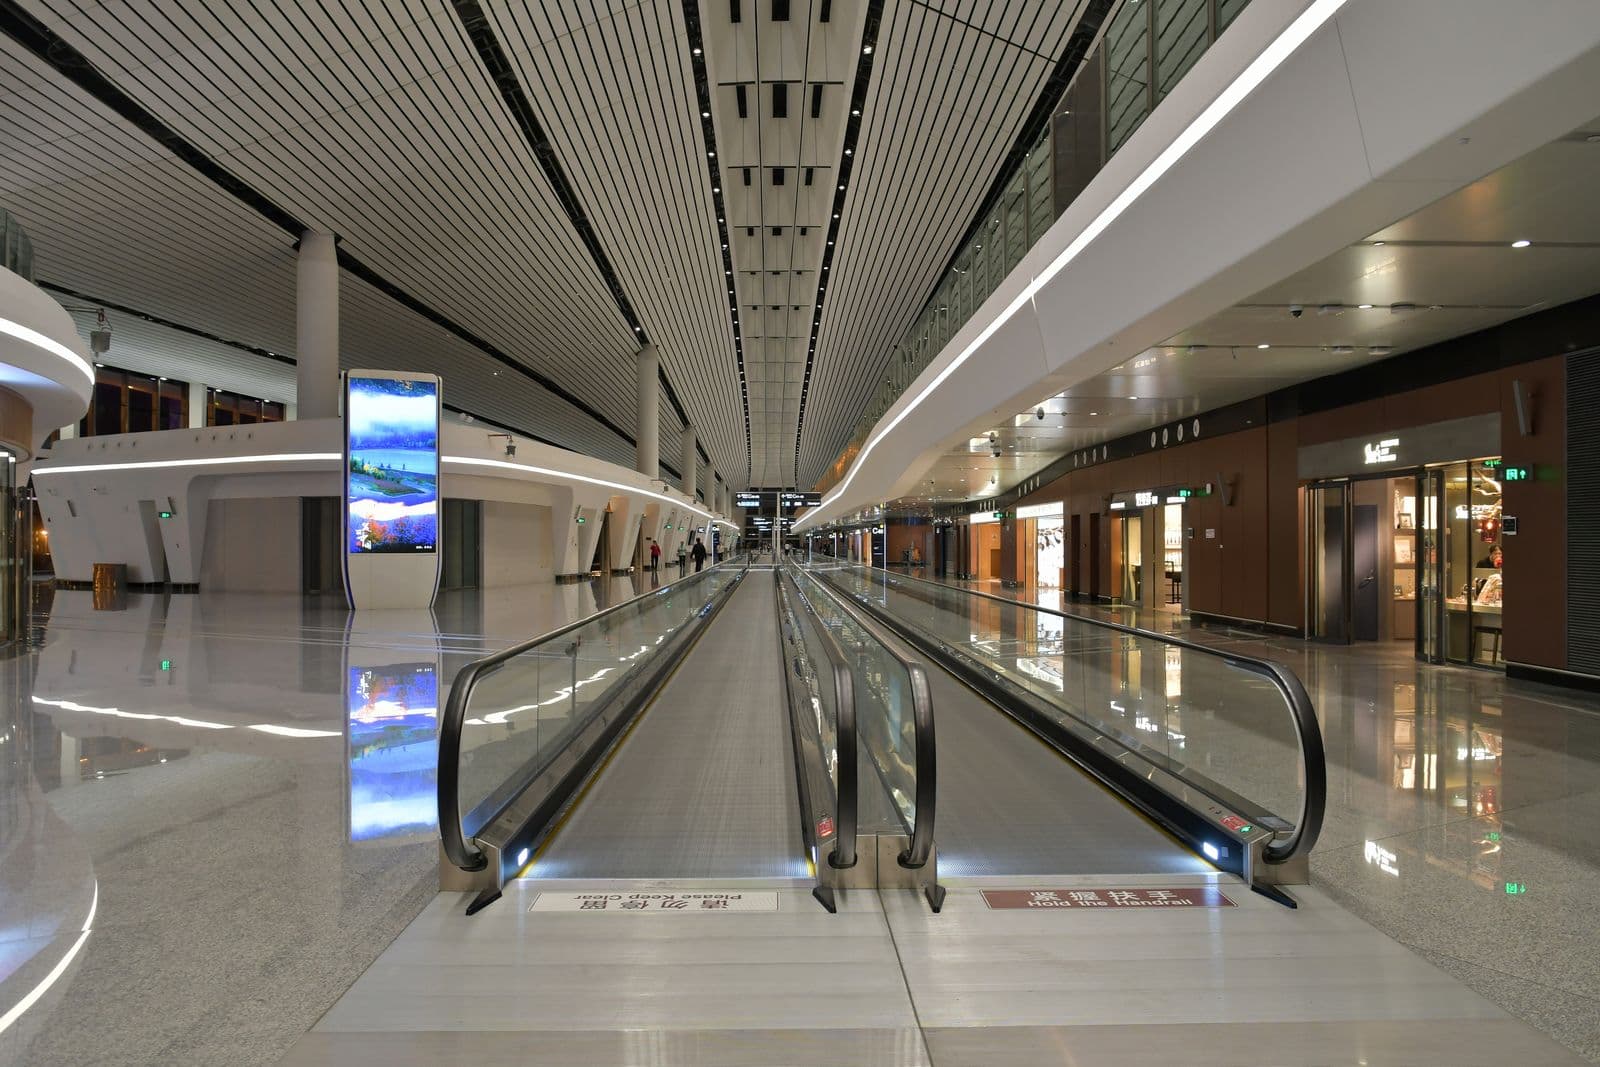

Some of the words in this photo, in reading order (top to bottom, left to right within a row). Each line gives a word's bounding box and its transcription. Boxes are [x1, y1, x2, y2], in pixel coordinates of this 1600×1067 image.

[627, 893, 675, 901] Keep
[1030, 890, 1179, 902] 紧握扶手
[579, 899, 729, 910] 请勿停留
